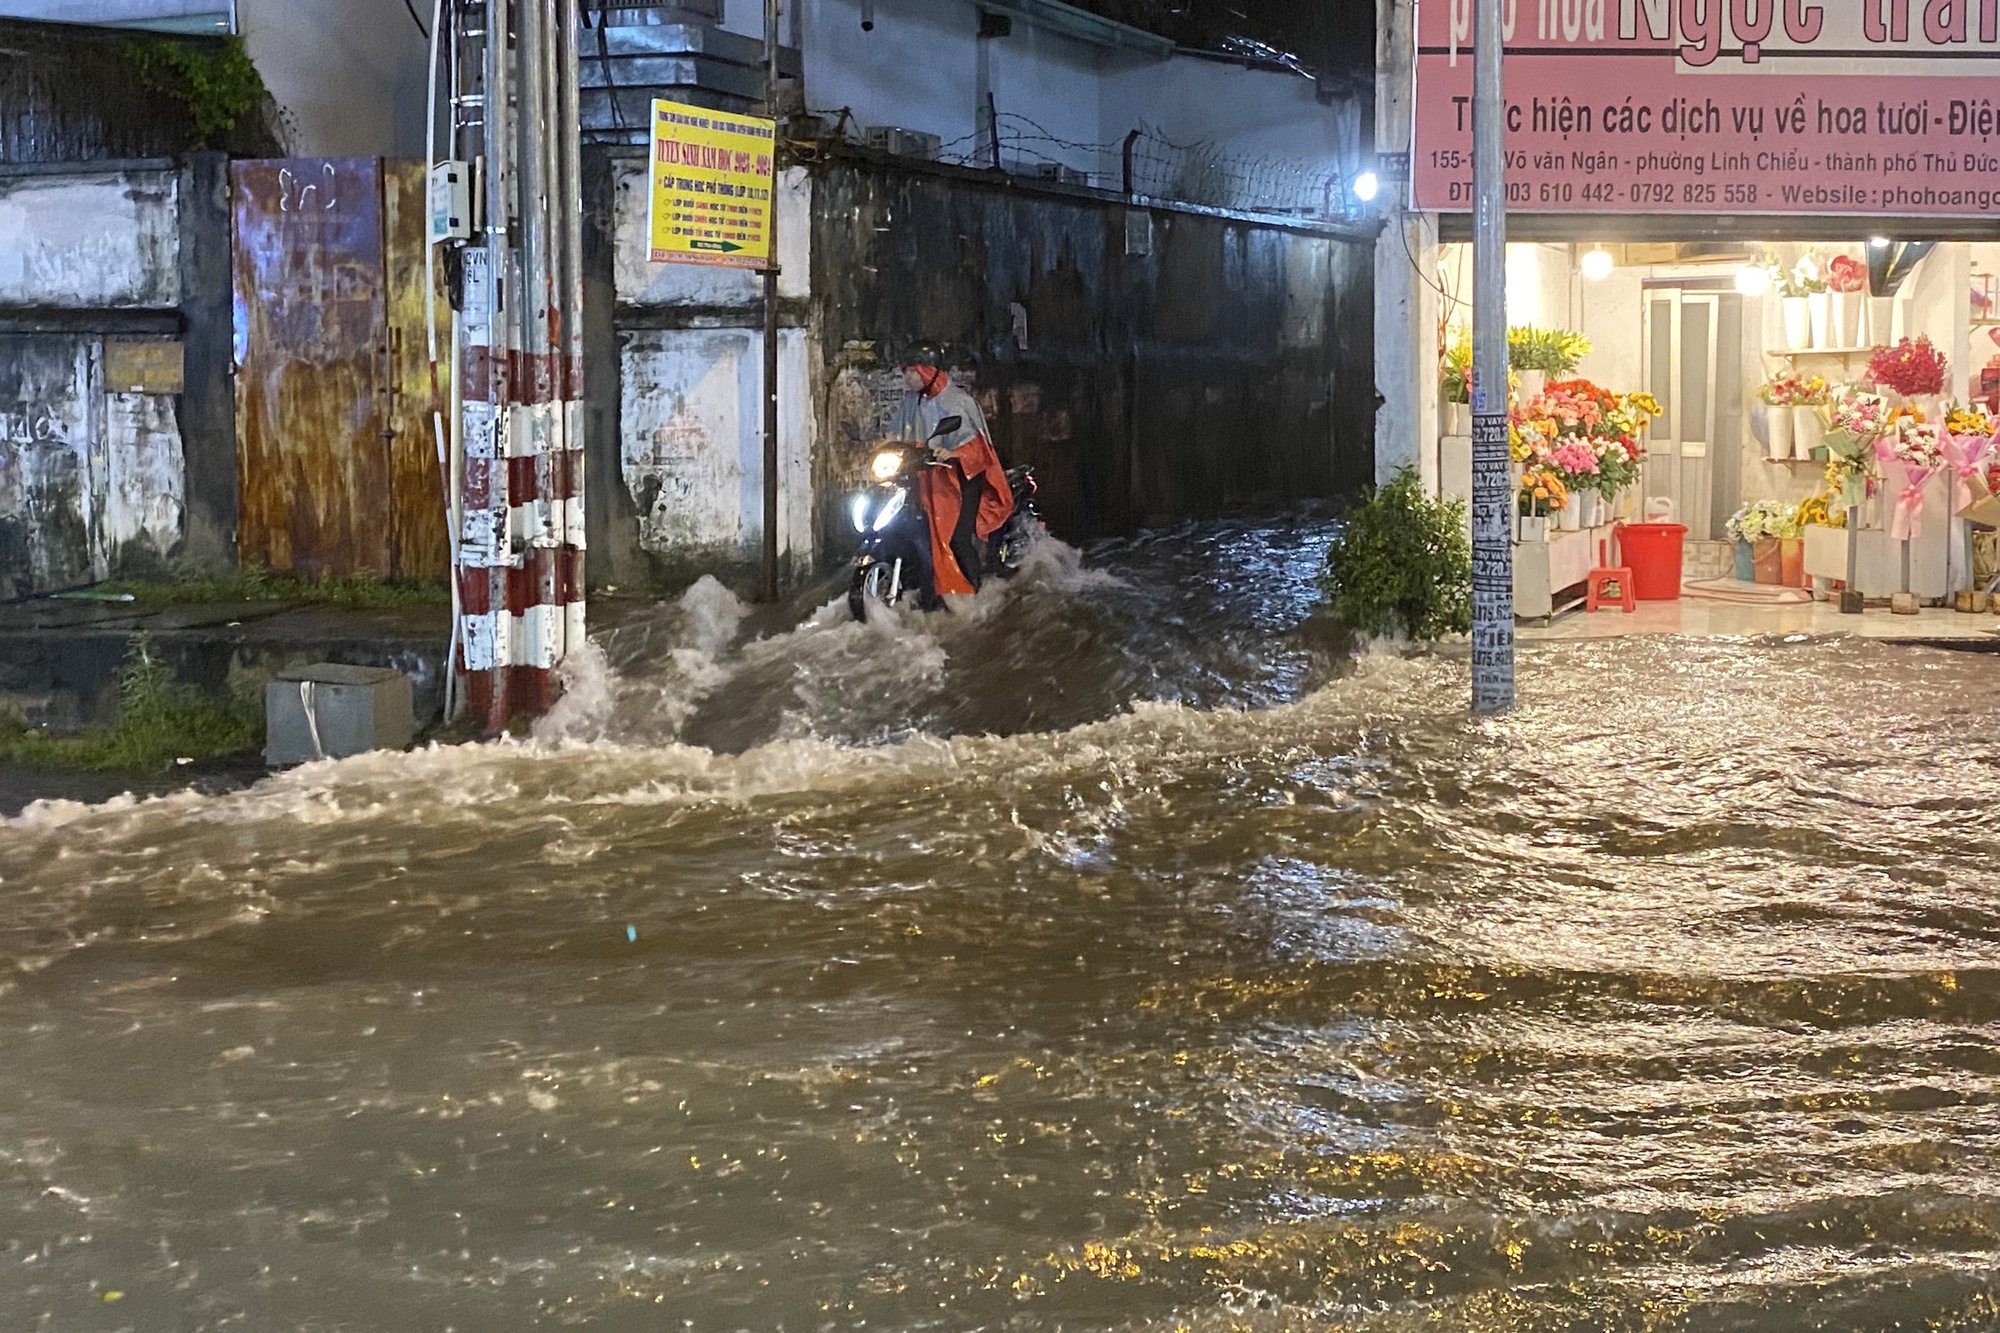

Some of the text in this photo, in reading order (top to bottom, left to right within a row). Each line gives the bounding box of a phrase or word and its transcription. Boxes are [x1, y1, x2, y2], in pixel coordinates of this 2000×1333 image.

[1532, 96, 1591, 141] hiện
[1602, 96, 1651, 133] các
[1661, 97, 1720, 141] dịch
[1732, 107, 1763, 141] vụ
[1775, 92, 1806, 134] về
[1818, 98, 1867, 134] hoa
[1877, 99, 1928, 135] tươi
[1949, 98, 2000, 143] Điệ
[1504, 150, 1526, 169] Võ
[1533, 151, 1565, 169] văn
[1571, 150, 1618, 174] Ngân
[1636, 151, 1704, 175] phường
[1711, 152, 1750, 170] Linh
[1756, 147, 1809, 171] Chiểu
[1826, 152, 1877, 171] thành
[1883, 150, 1918, 176] phố
[1923, 151, 1957, 172] Thủ
[1964, 152, 1998, 172] Đức
[1540, 182, 1572, 201] 610
[1581, 183, 1613, 202] 442
[1630, 183, 1674, 202] 0792
[1683, 184, 1716, 203] 825
[1724, 184, 1758, 203] 558
